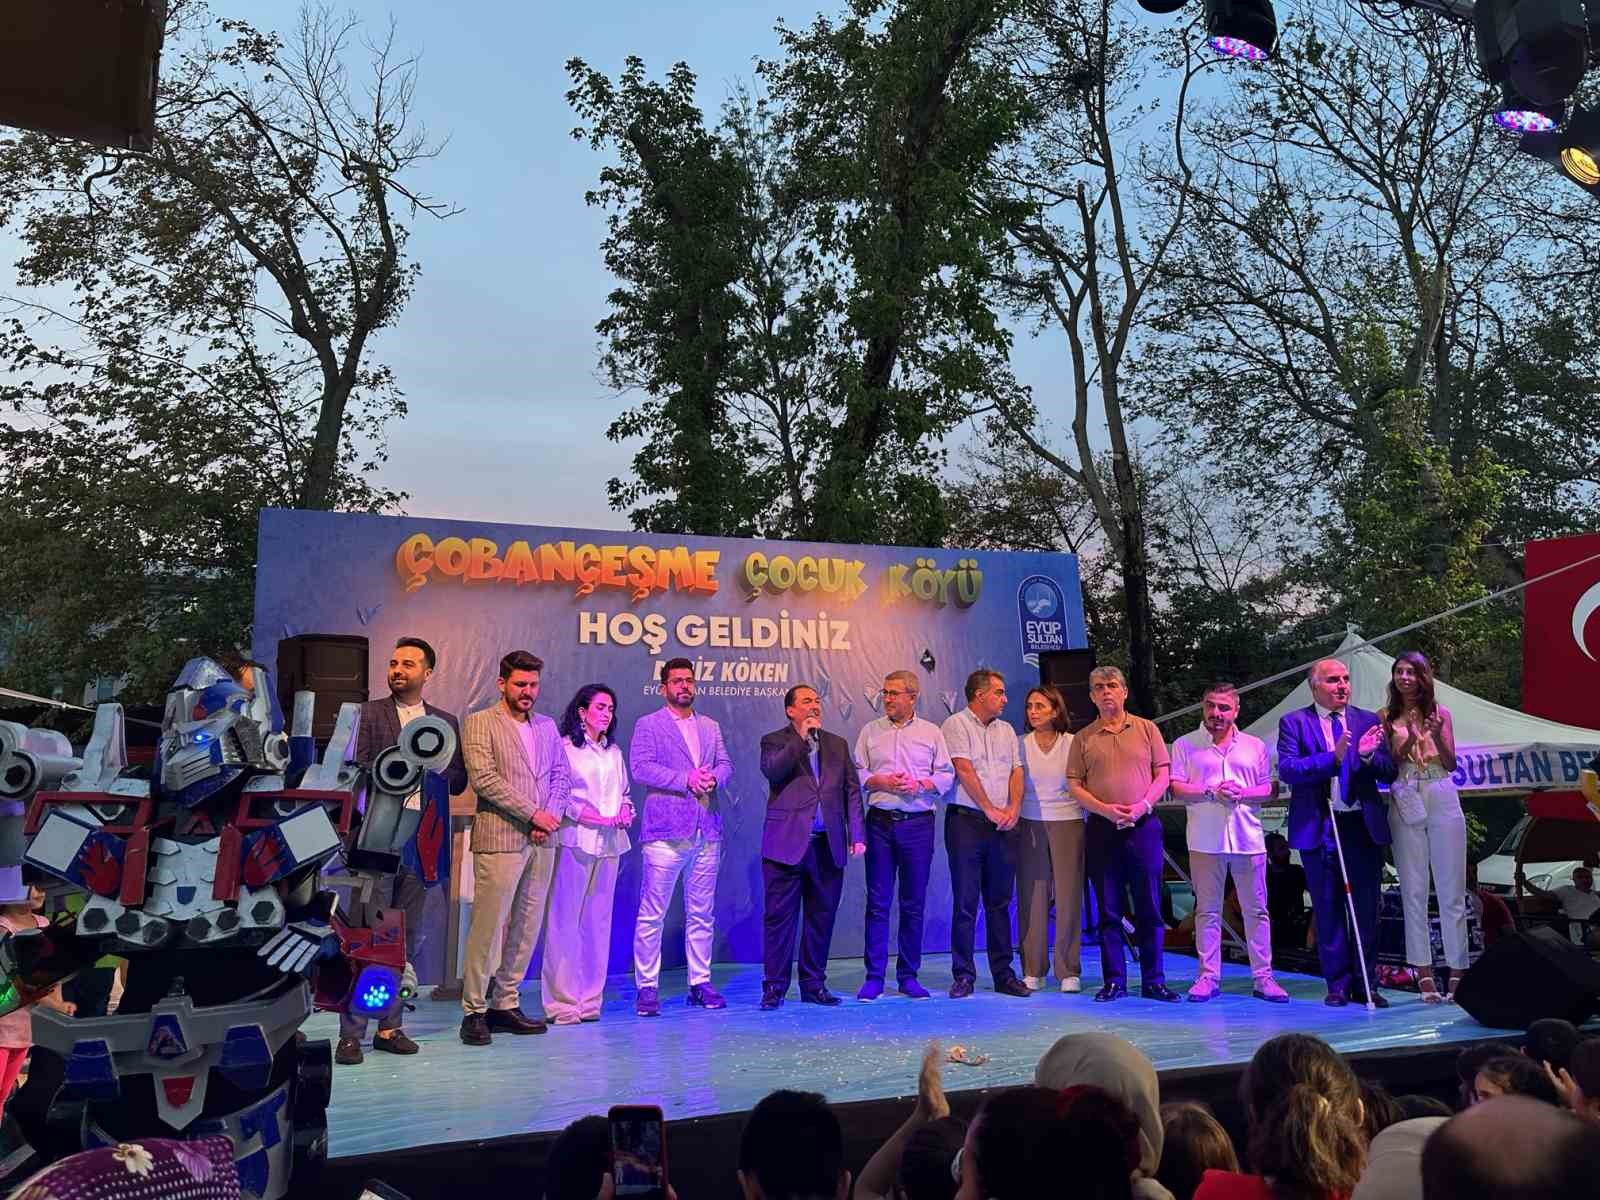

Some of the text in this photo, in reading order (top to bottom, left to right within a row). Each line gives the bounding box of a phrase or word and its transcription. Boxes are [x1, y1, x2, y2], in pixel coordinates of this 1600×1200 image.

[396, 533, 721, 602] ÇOBANÇEŞME
[744, 551, 869, 603] ÇOCUK
[886, 557, 984, 609] KÖYÜ
[579, 609, 851, 655] HOŞ GELDİNİZ
[1027, 634, 1063, 644] SULTAN
[653, 656, 789, 682] DİZ KÖKEN
[1452, 750, 1553, 786] SULTAN
